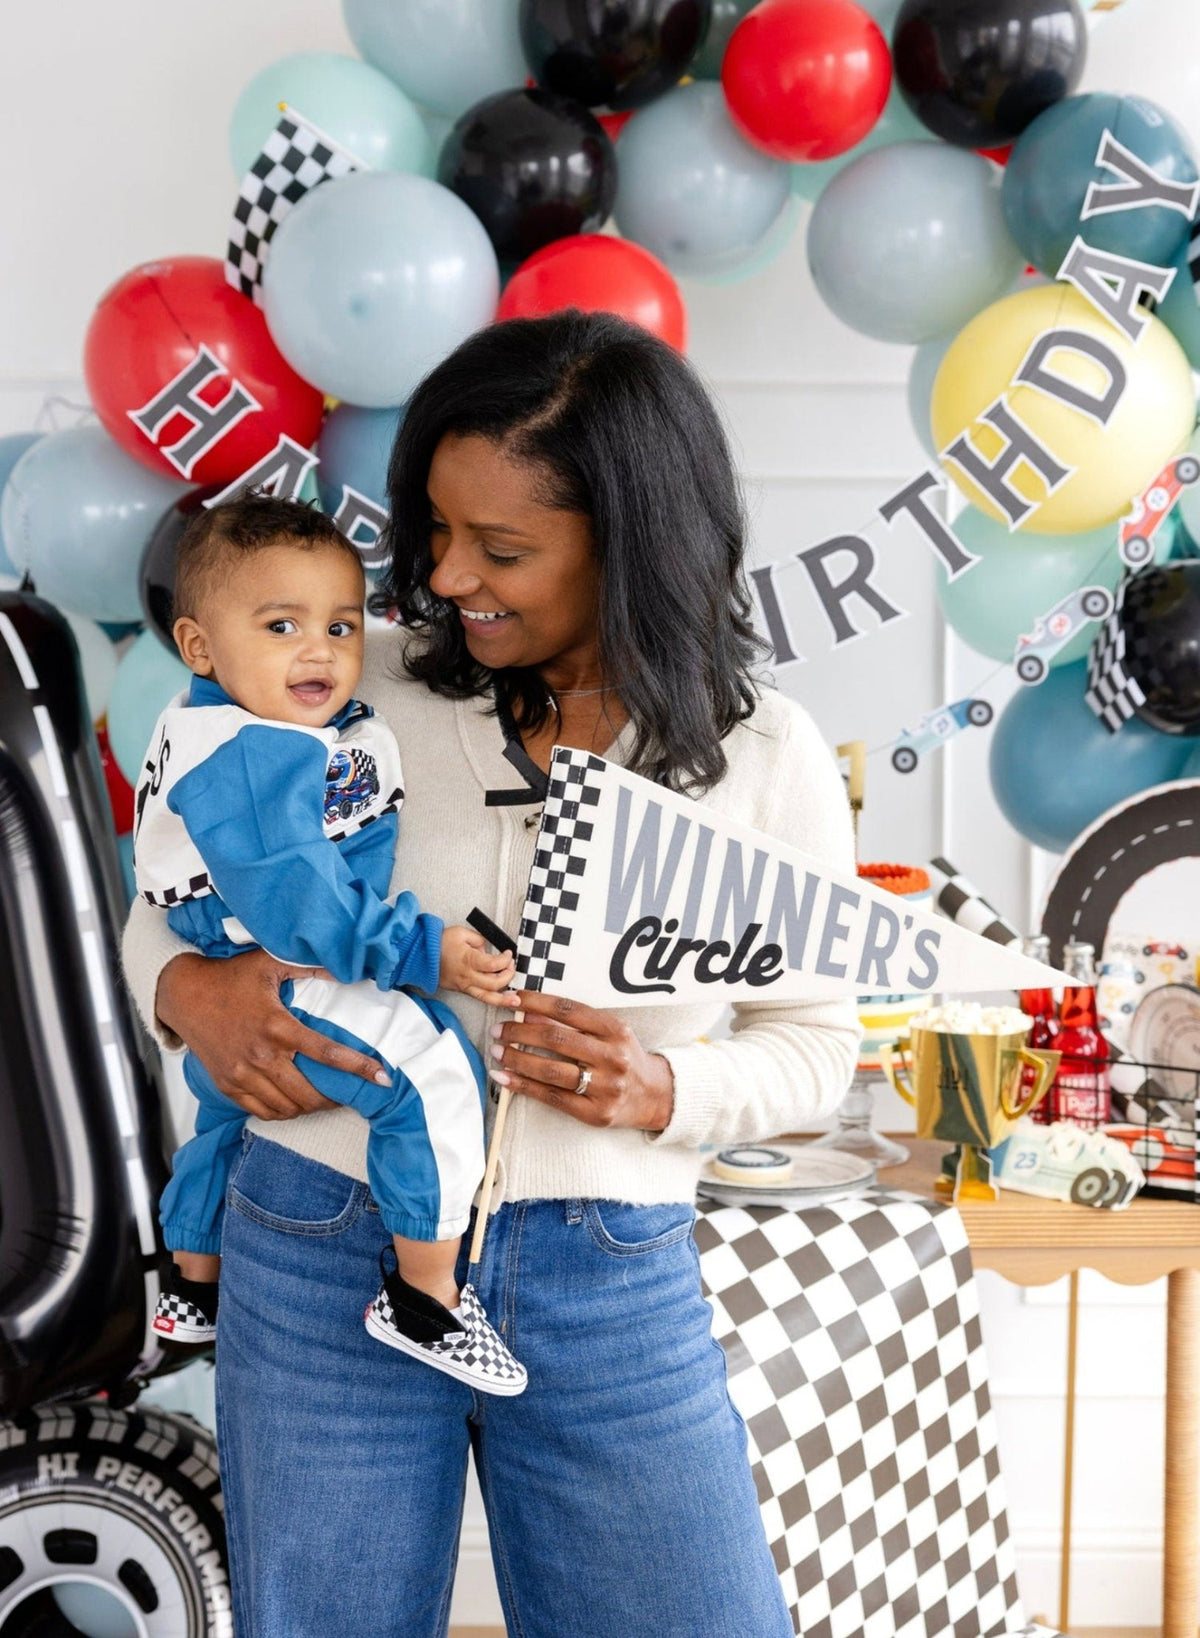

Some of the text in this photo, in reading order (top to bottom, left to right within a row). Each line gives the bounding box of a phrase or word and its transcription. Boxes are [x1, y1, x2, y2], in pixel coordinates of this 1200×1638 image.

[748, 130, 1199, 665] IRTHDAY
[603, 785, 942, 991] WINNER'S
[609, 916, 785, 994] Circle
[1014, 1151, 1038, 1169] 23
[37, 1453, 80, 1480] HI
